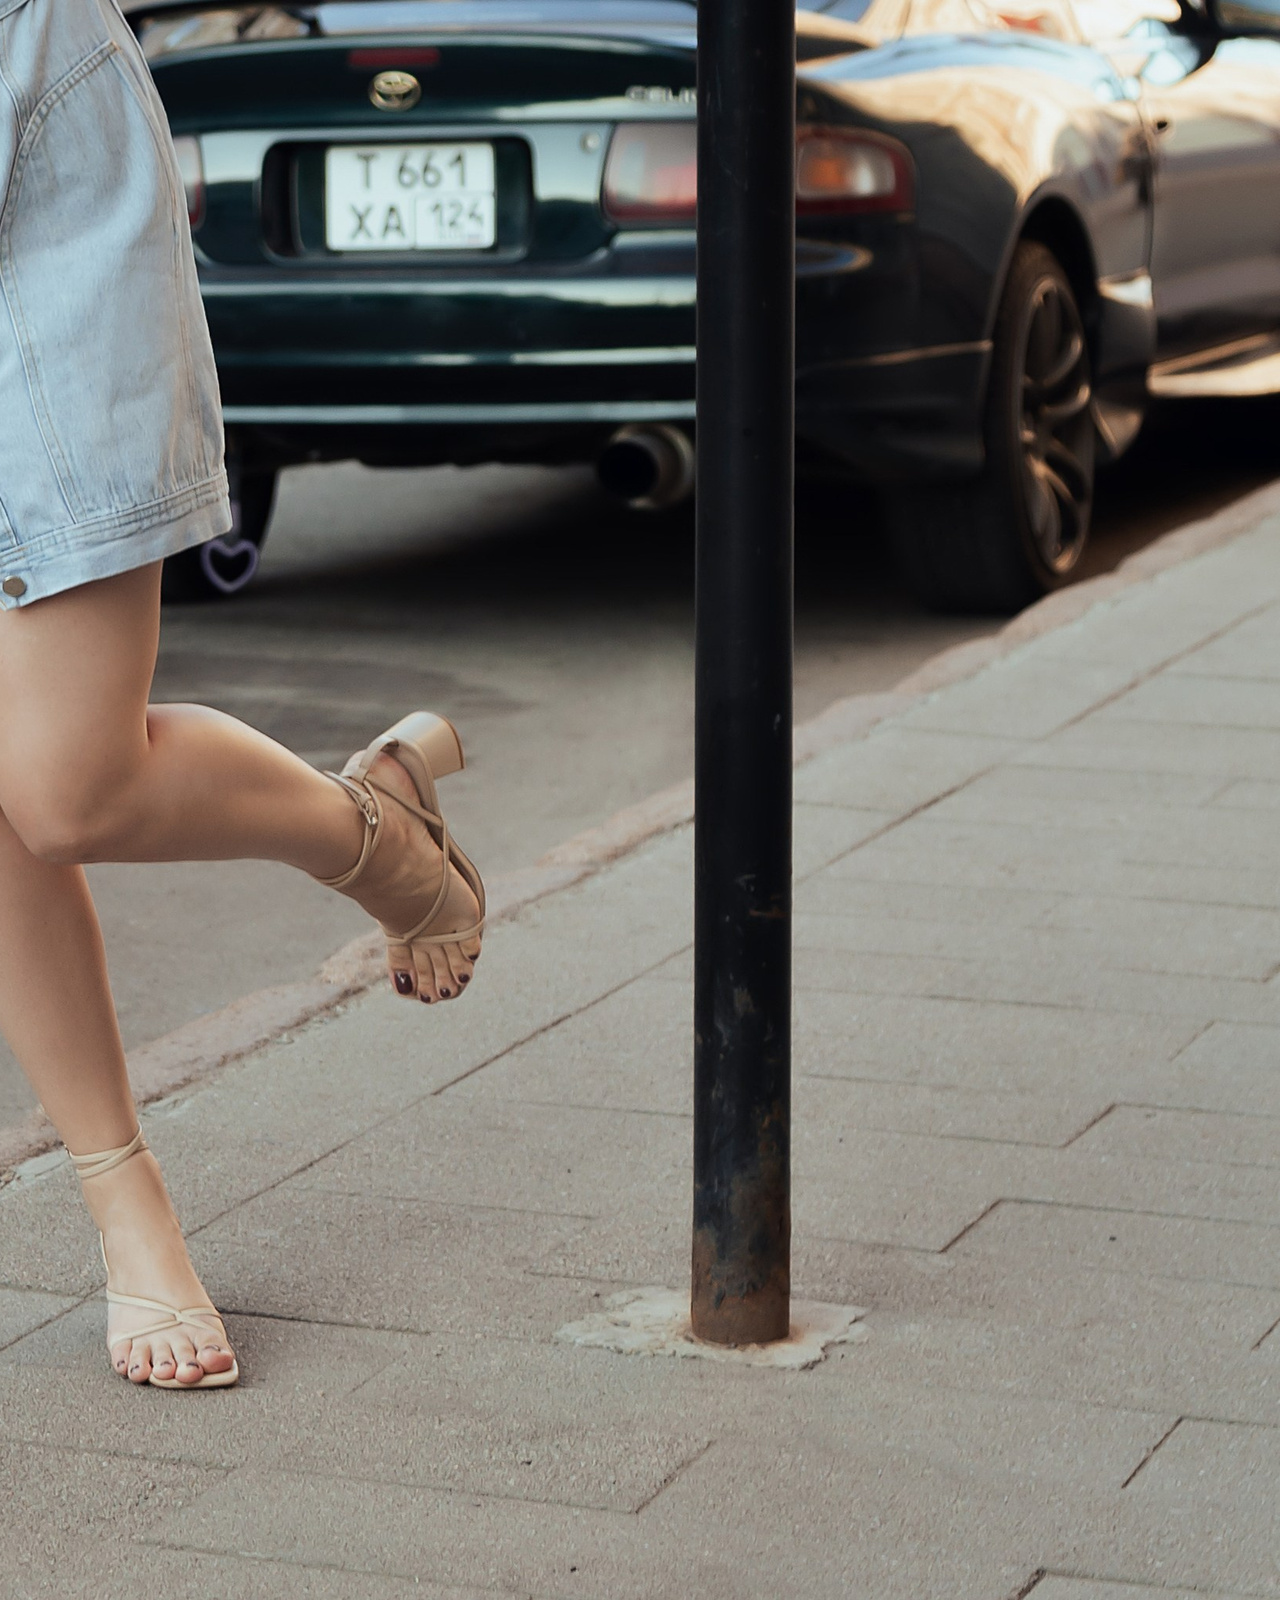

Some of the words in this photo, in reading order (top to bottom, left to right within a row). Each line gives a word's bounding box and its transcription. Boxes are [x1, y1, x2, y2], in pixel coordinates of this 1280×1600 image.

[356, 151, 381, 189] Т
[397, 150, 467, 189] 661
[350, 203, 406, 240] ХА
[431, 201, 485, 229] 124
